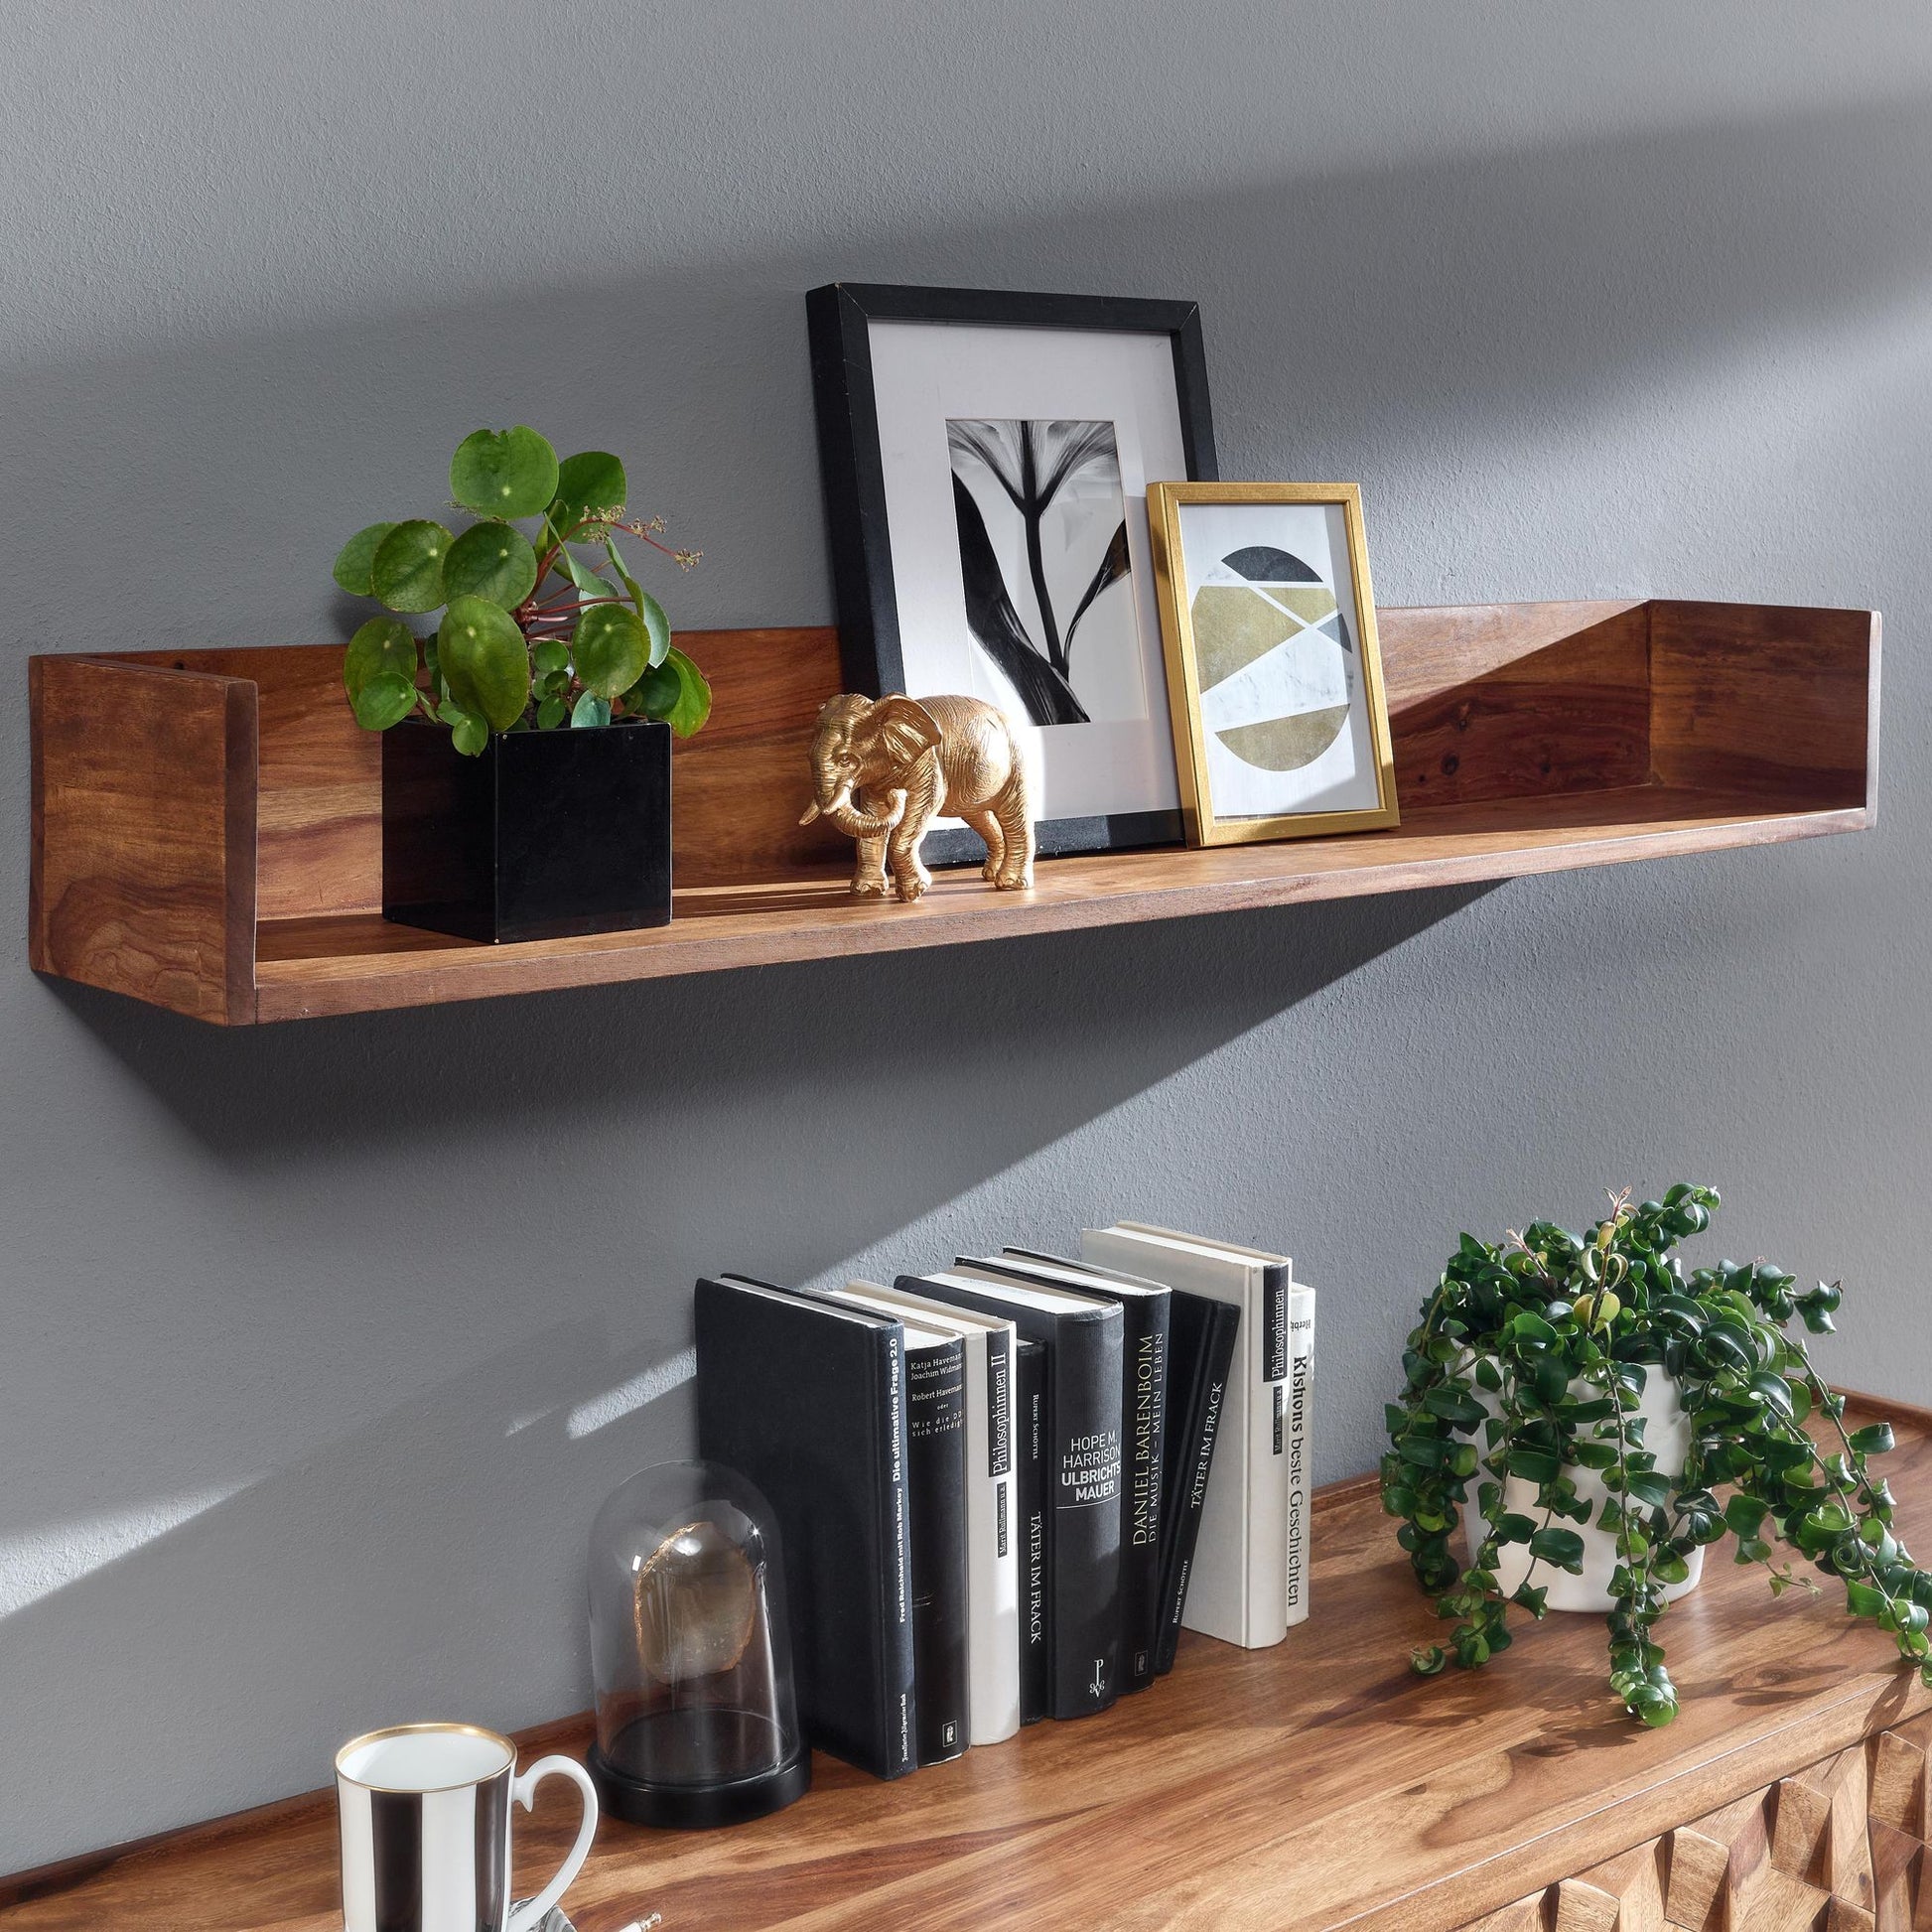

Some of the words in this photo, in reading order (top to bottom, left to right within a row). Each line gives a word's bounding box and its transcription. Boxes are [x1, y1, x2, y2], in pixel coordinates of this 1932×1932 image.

[1272, 1289, 1286, 1378] Philosophinnen
[891, 1359, 899, 1395] Frage
[910, 1361, 931, 1370] Katja
[932, 1353, 962, 1366] Haveman
[910, 1370, 939, 1381] Joachim
[991, 1353, 1006, 1367] II
[1154, 1333, 1164, 1382] LEBEN
[911, 1391, 935, 1401] Robert
[953, 1410, 962, 1420] DD
[1135, 1335, 1153, 1460] BARENBOIM
[1153, 1391, 1162, 1433] MEIN
[1204, 1382, 1223, 1433] FRACK
[1292, 1356, 1308, 1433] Kishons
[892, 1396, 900, 1458] ultimative
[911, 1428, 931, 1438] sich
[992, 1369, 1009, 1474] Philosophinnen
[1071, 1433, 1105, 1451] HOPE
[1108, 1430, 1117, 1444] M.
[1063, 1444, 1121, 1469] HARRISON
[1200, 1436, 1213, 1457] IM
[1291, 1437, 1304, 1485] beste
[1061, 1460, 1121, 1485] ULBRICHTS
[1075, 1482, 1114, 1501] MAUER
[1150, 1453, 1160, 1507] MUSIK
[1190, 1461, 1207, 1508] TÄTER
[1133, 1465, 1149, 1545] DANIEL
[1031, 1511, 1040, 1563] TÄTER
[1149, 1514, 1158, 1542] DIE
[1288, 1490, 1303, 1606] Geschichten
[1031, 1566, 1040, 1587] IM
[1031, 1590, 1040, 1644] FRACK
